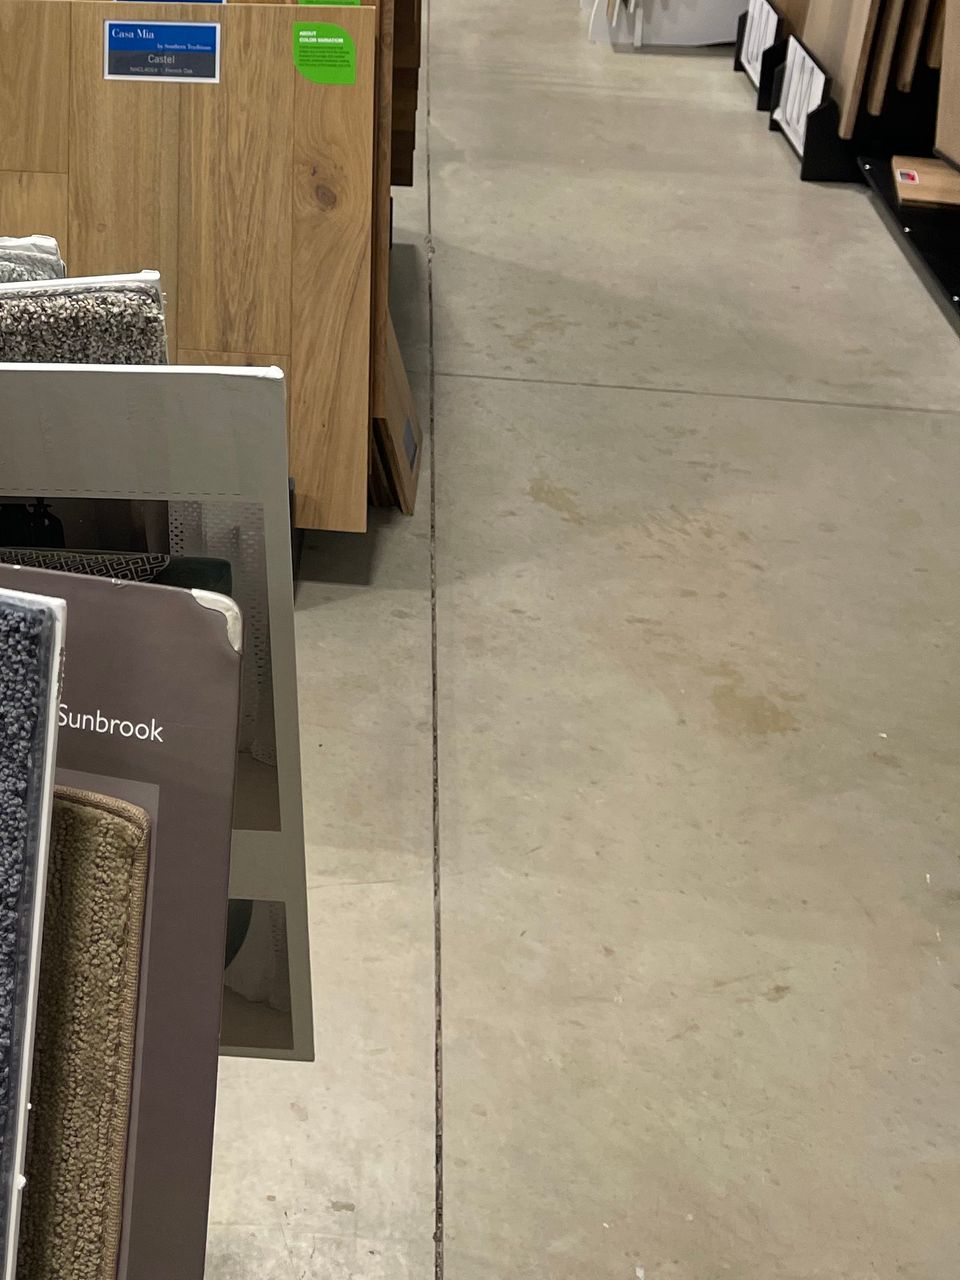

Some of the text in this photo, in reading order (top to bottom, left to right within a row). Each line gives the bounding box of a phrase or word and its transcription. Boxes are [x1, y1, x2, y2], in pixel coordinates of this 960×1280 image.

[112, 28, 155, 39] Casa Mia
[147, 54, 176, 64] Castel
[58, 704, 164, 742] Sunbrook
